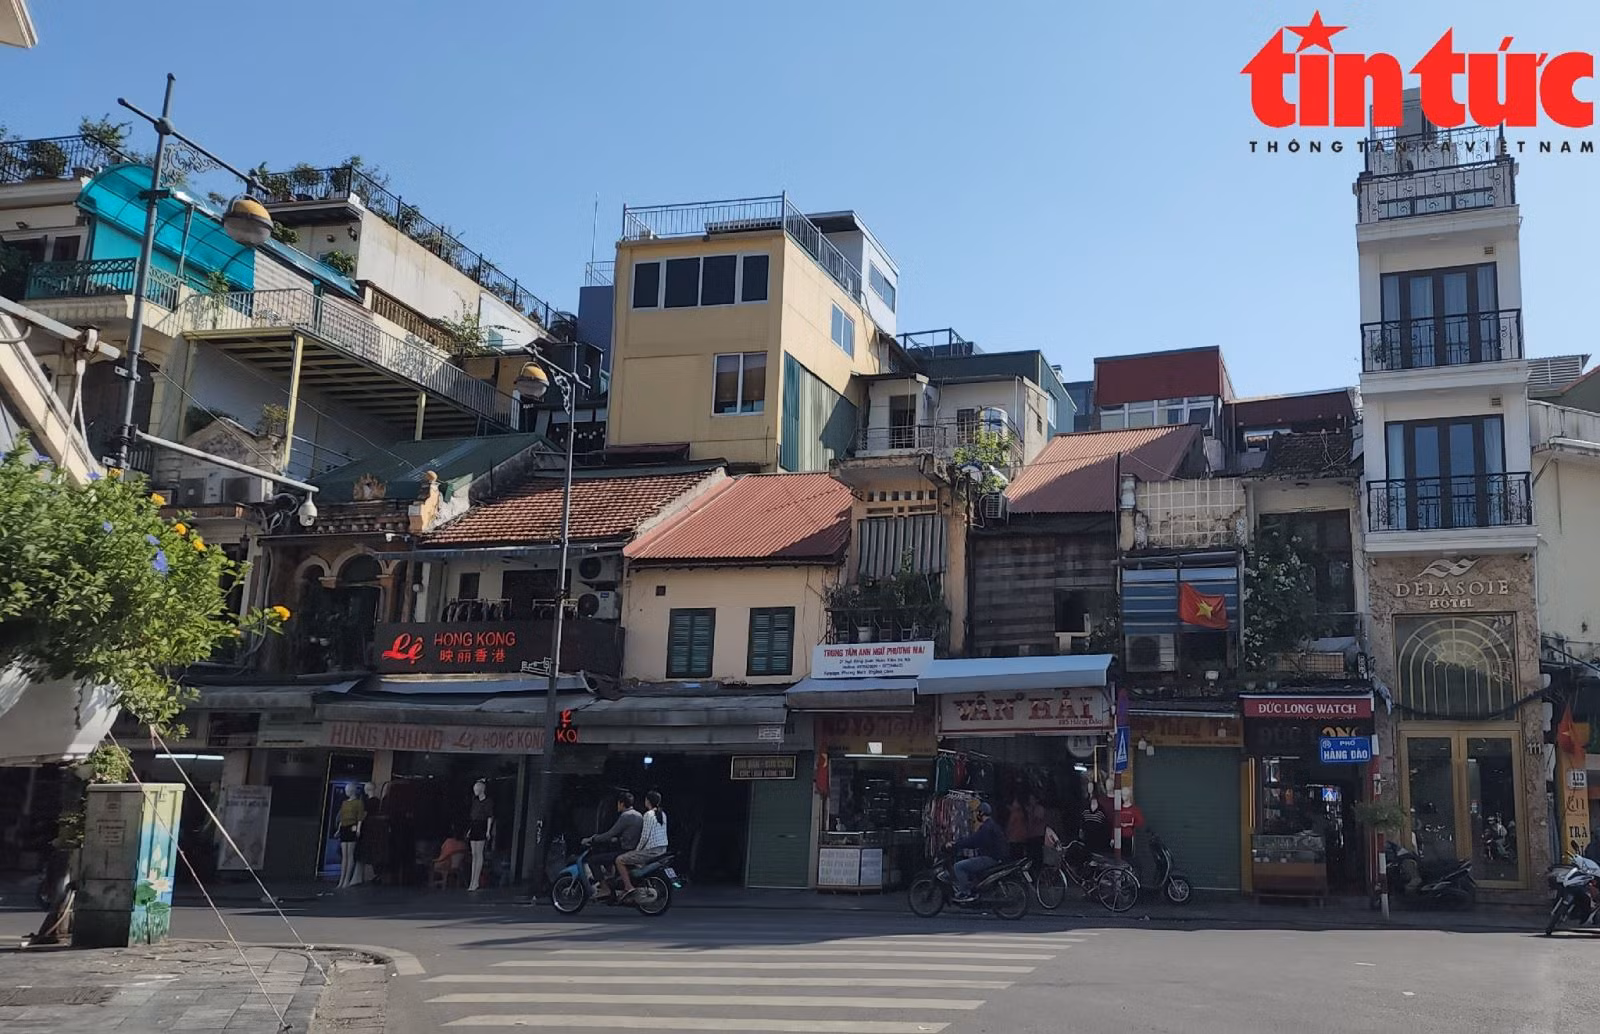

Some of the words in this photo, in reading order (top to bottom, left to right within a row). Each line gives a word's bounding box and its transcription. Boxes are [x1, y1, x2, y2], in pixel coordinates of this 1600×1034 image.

[1395, 580, 1510, 597] DELASOIE
[1429, 598, 1475, 609] HOTEL
[434, 631, 473, 647] HONG
[476, 631, 517, 647] KONG
[440, 648, 506, 663] 映丽香港
[823, 648, 844, 657] TRUNG
[845, 647, 858, 657] TÂM
[858, 648, 871, 656] ANH
[953, 693, 1016, 721] VÂN
[1028, 690, 1093, 720] HẢI
[1258, 701, 1282, 714] ĐỨC
[1284, 703, 1314, 714] LONG
[1316, 703, 1357, 714] WATCH
[484, 730, 514, 748] HONG
[1323, 748, 1348, 760] HÀNG
[1350, 748, 1368, 760] ĐÀO
[1568, 822, 1588, 838] TRÀ
